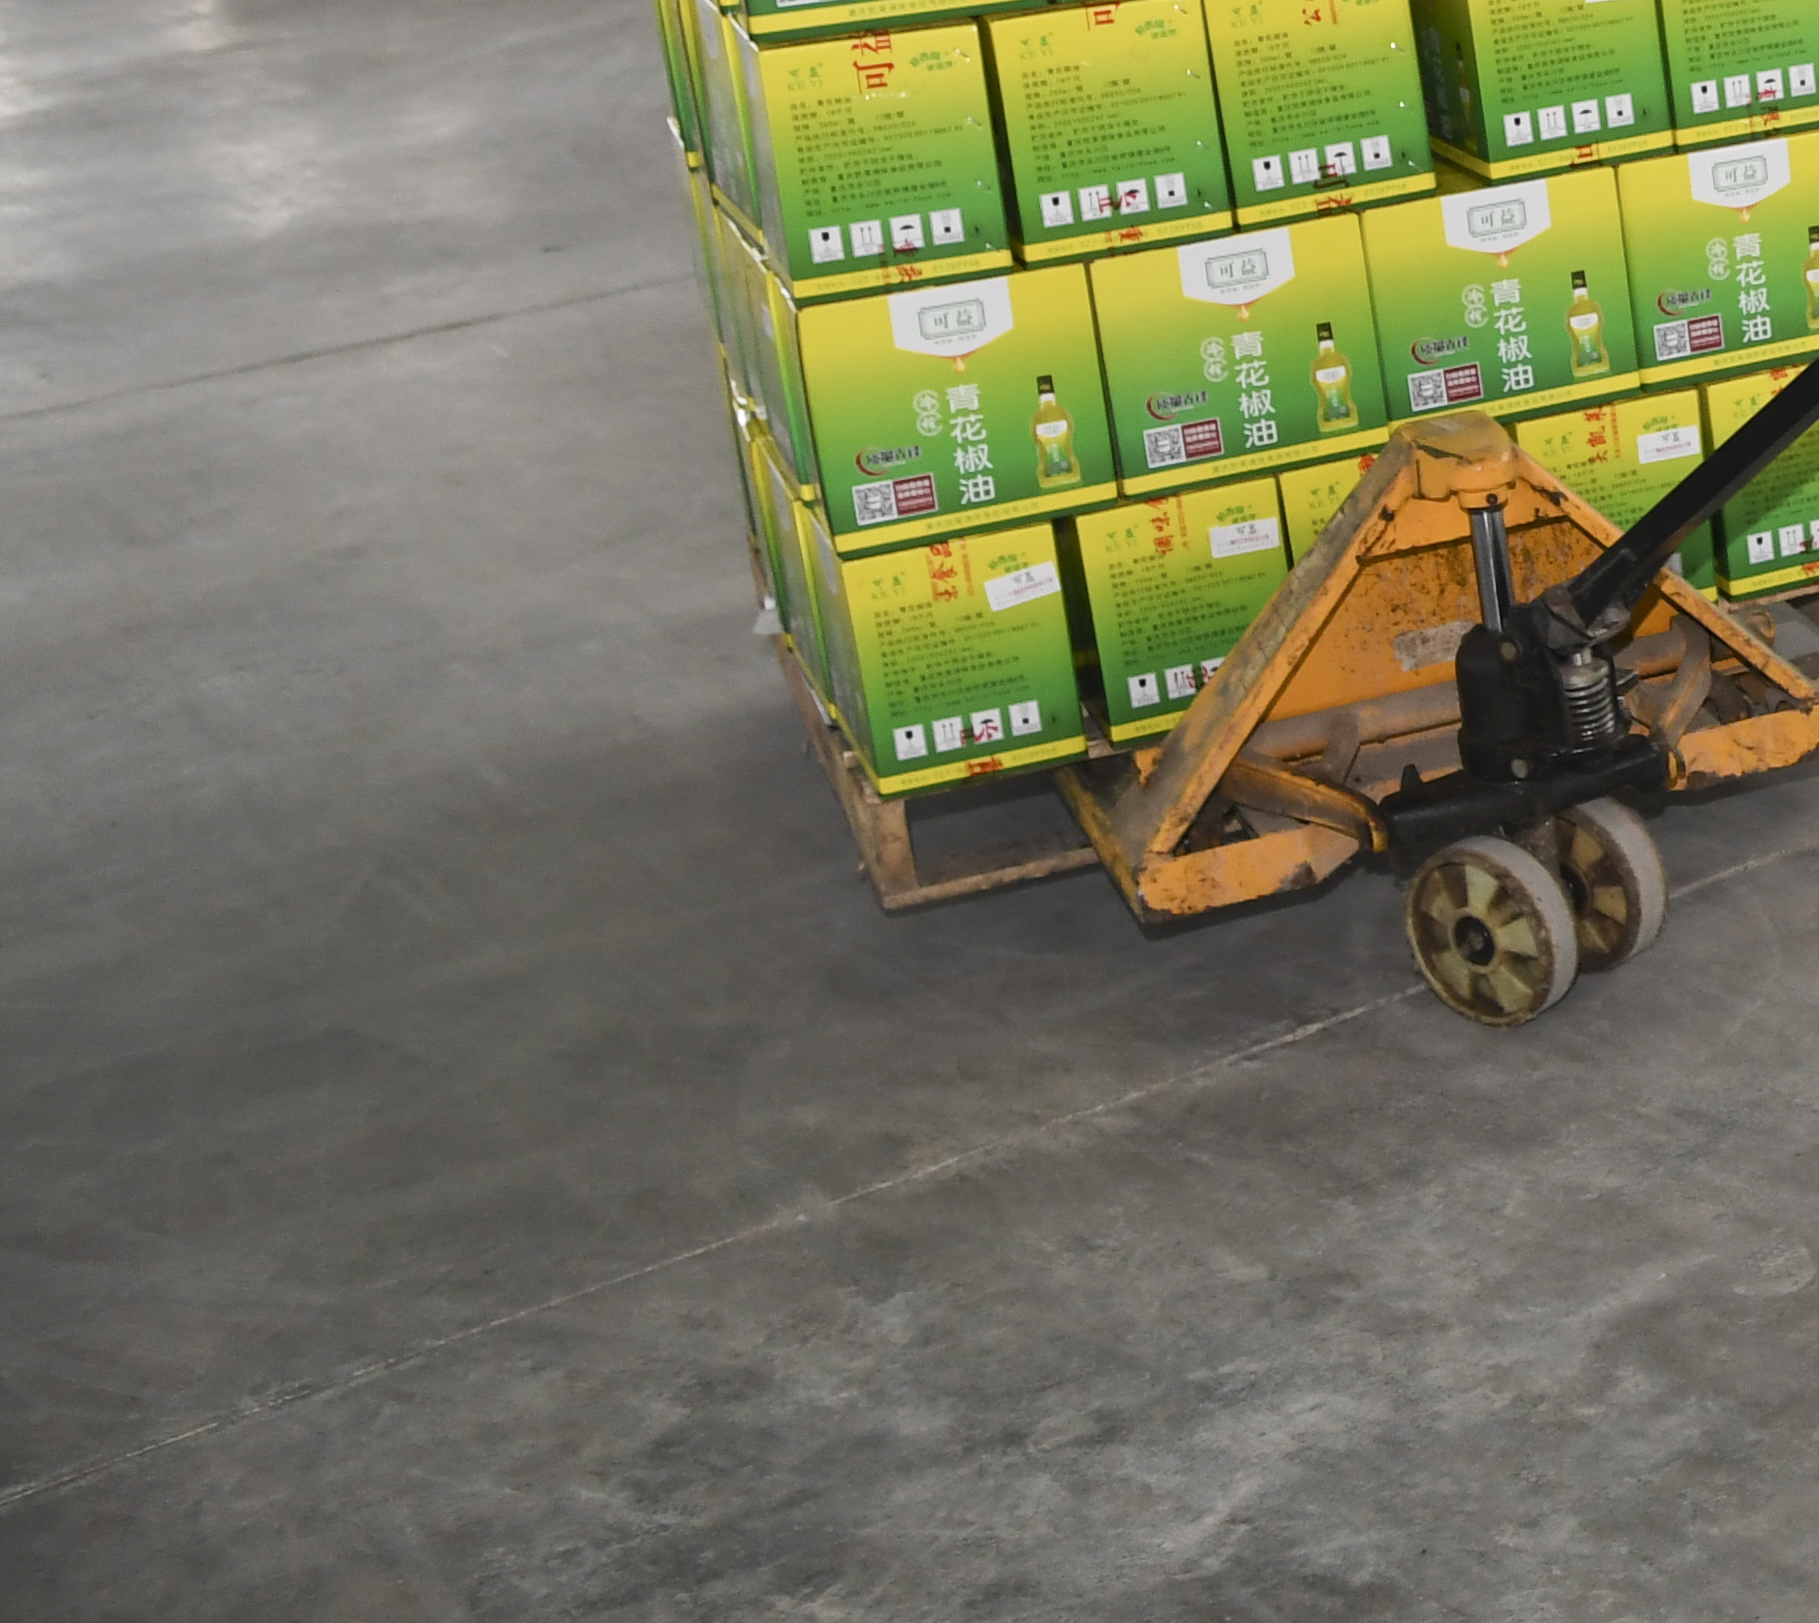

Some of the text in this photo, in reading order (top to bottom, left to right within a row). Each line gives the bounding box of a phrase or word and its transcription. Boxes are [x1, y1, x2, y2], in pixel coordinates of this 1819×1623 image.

[1724, 165, 1758, 184] 可益
[1479, 209, 1517, 228] 可益
[1218, 262, 1257, 279] 可益
[1733, 232, 1772, 343] 青花椒油
[932, 310, 975, 330] 可益
[1490, 278, 1534, 393] 青花椒油
[1230, 331, 1278, 449] 青花椒油
[946, 384, 996, 506] 青花椒油
